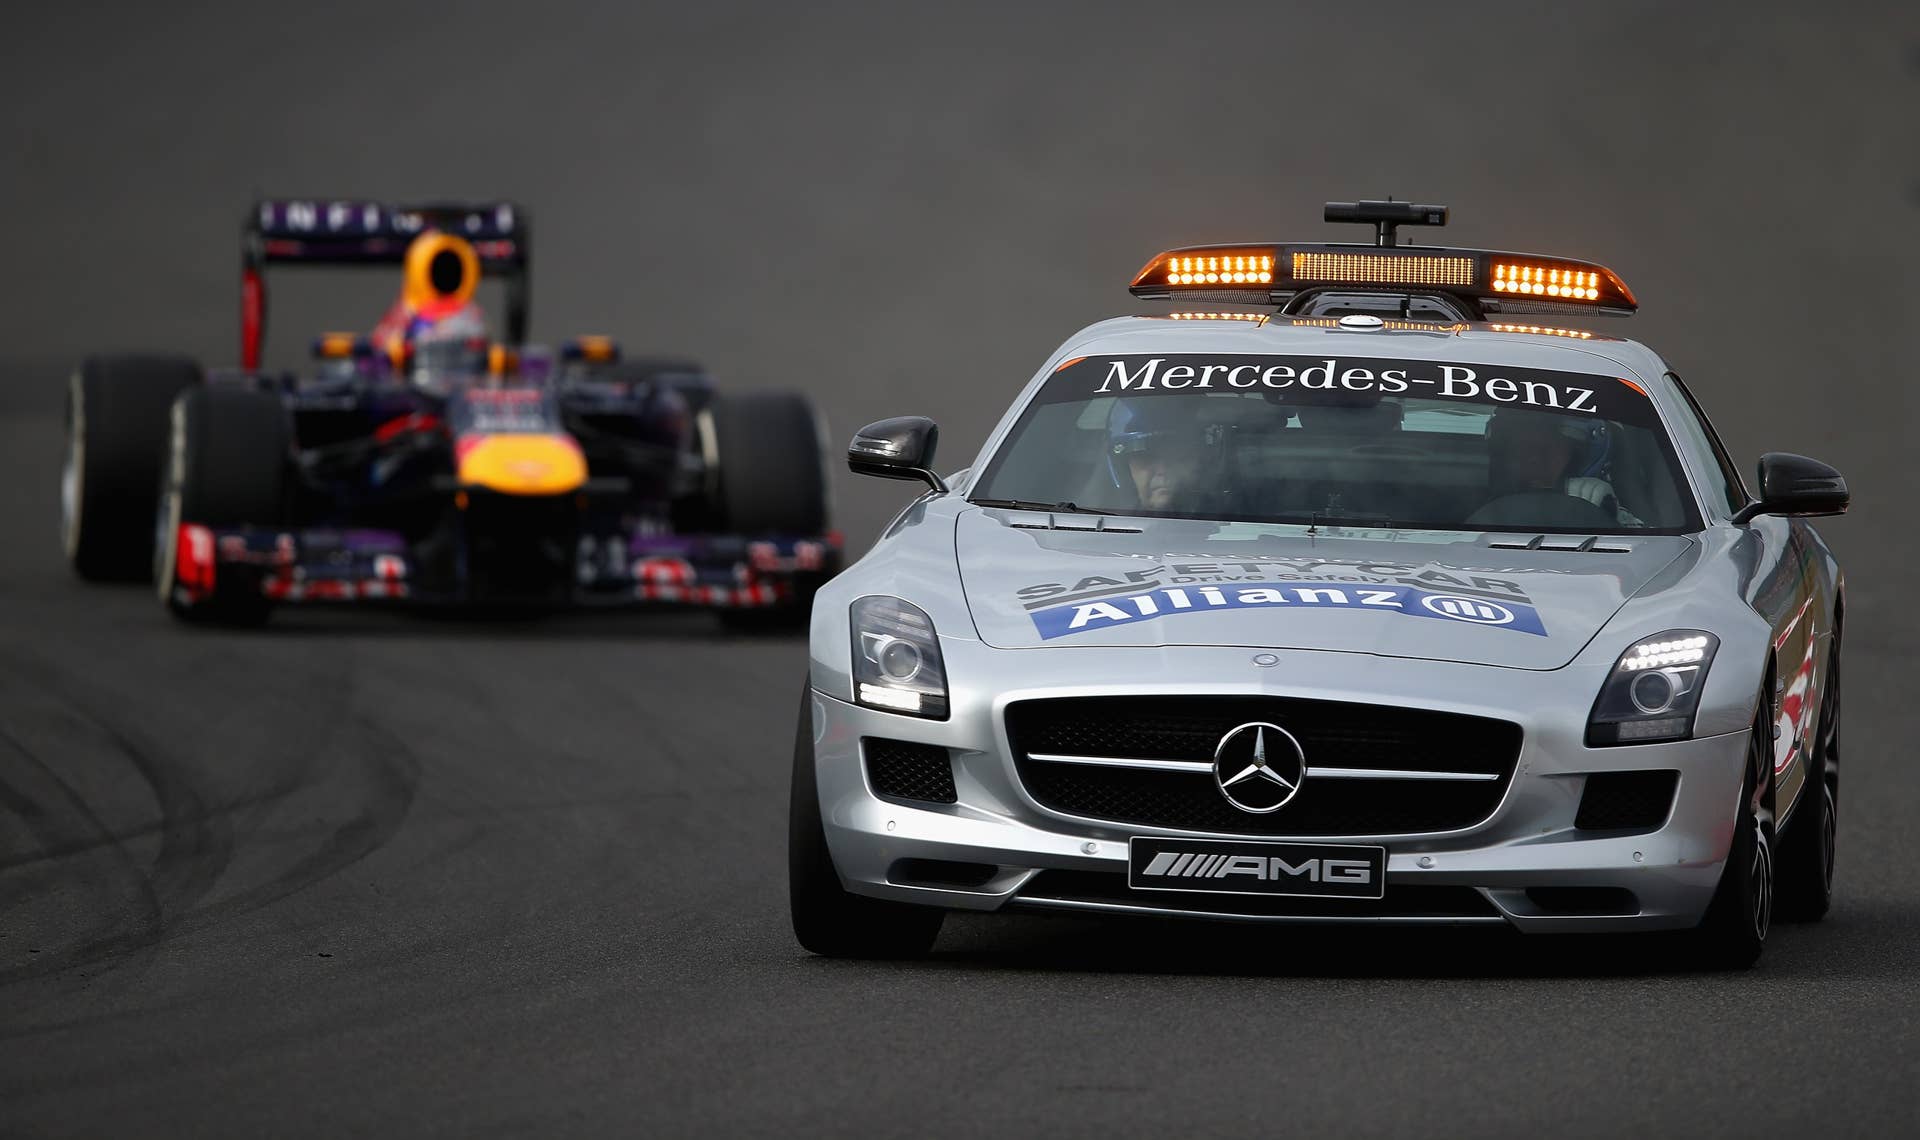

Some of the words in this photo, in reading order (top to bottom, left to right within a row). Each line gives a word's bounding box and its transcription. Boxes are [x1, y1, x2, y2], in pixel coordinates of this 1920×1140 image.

[1094, 358, 1598, 414] Mercedes-Benz
[1016, 562, 1326, 600] SAFETY
[1357, 565, 1526, 595] CAR
[1170, 574, 1266, 584] Drive
[1277, 573, 1388, 584] Safely
[1068, 586, 1404, 629] Allianz
[1213, 856, 1371, 884] AMG
